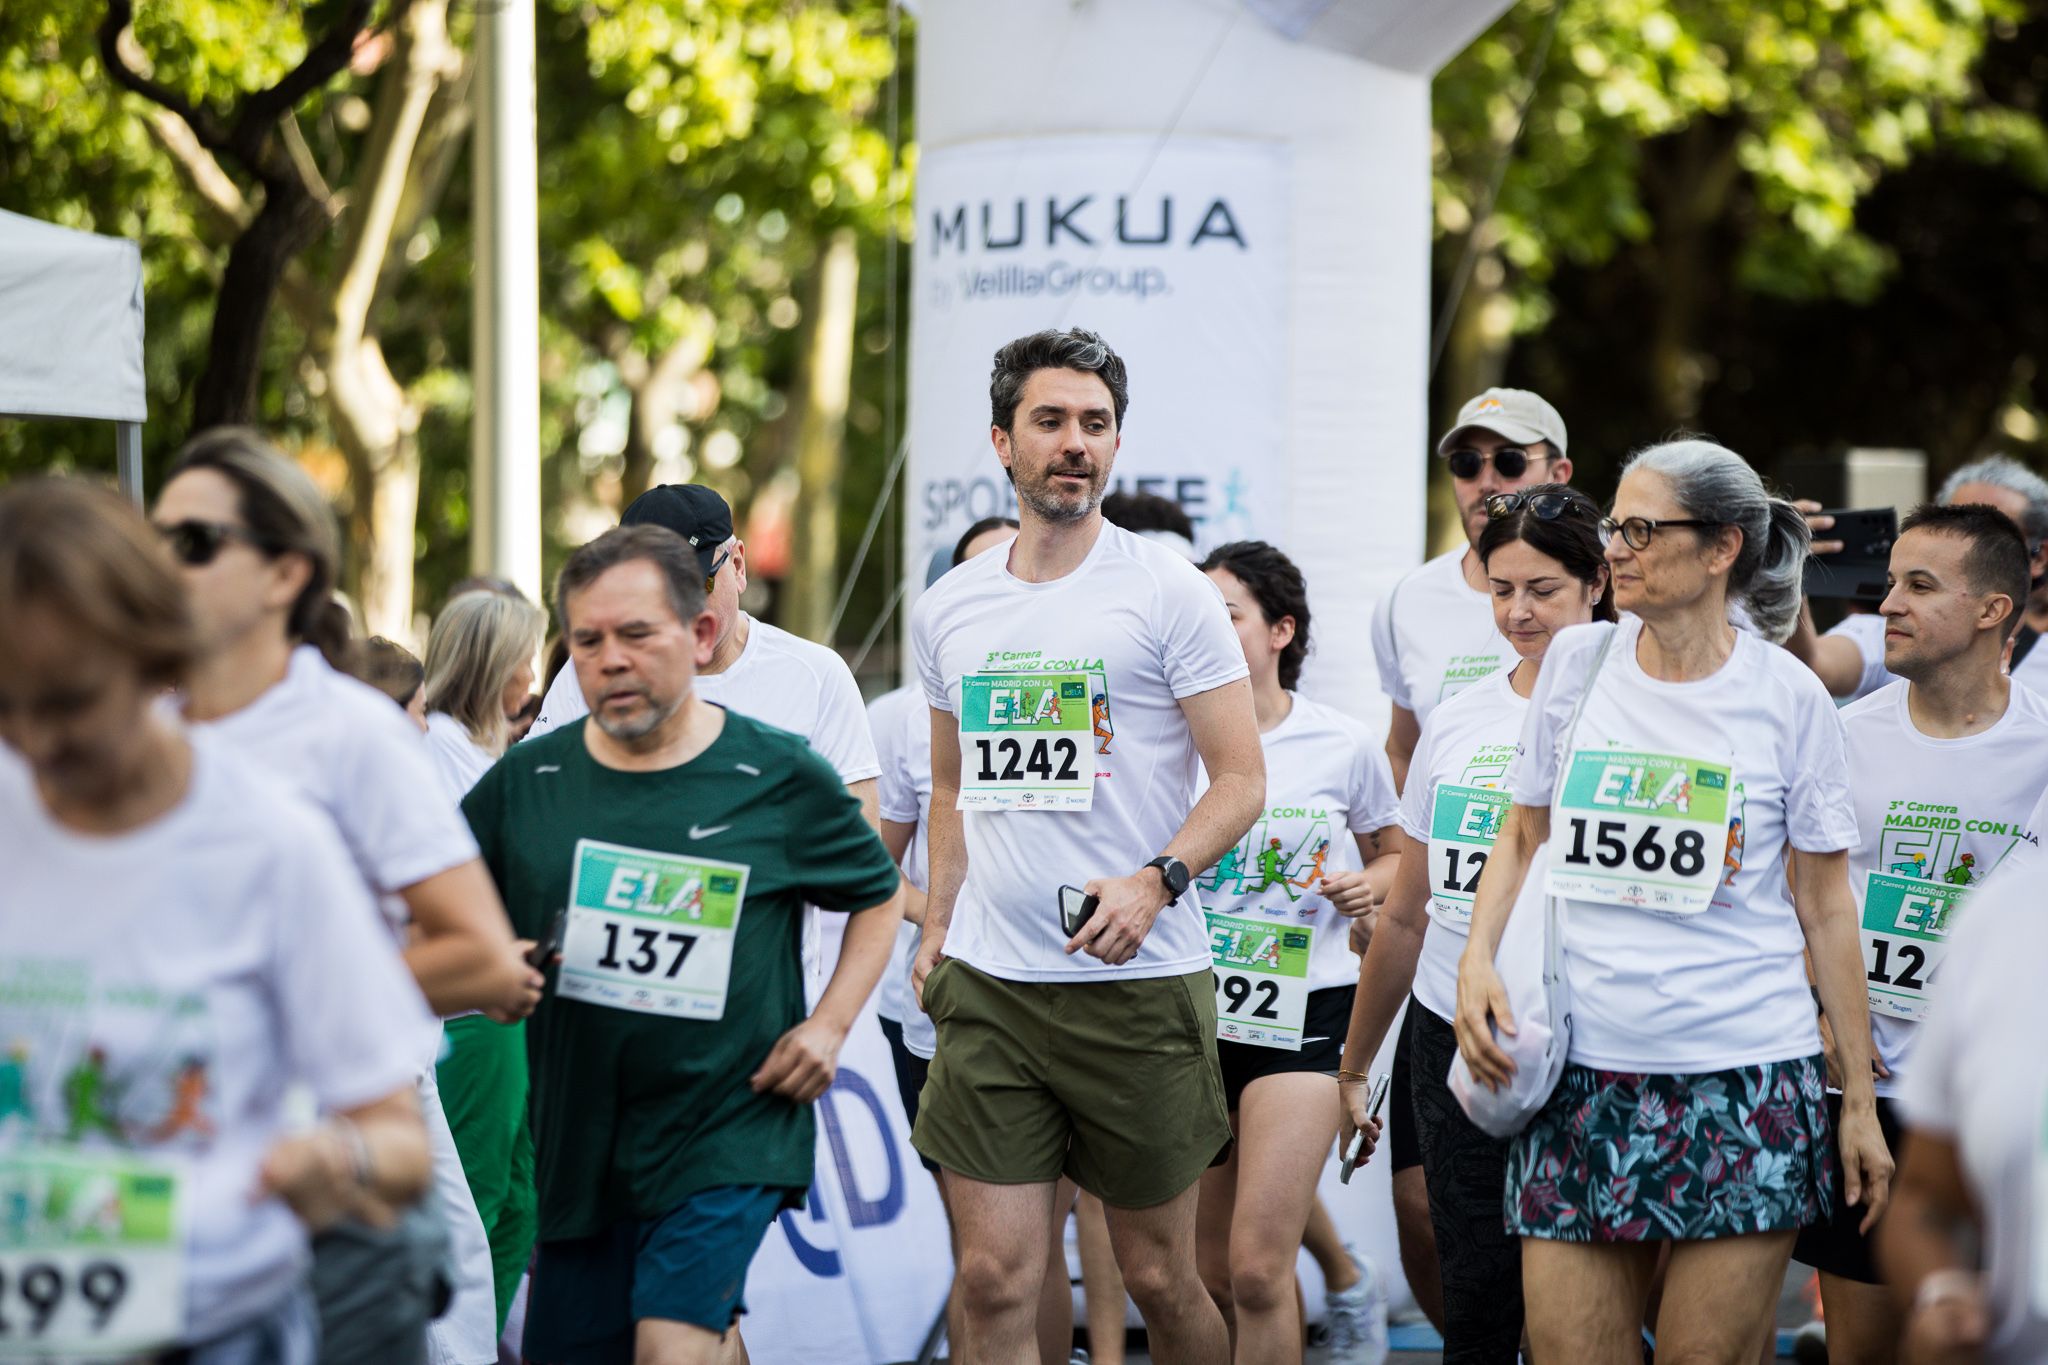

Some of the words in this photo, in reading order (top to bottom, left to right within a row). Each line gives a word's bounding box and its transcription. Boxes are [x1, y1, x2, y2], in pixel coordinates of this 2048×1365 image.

[931, 195, 1249, 257] MUKUA
[1002, 650, 1042, 661] Carrera
[1043, 660, 1080, 671] CON
[1082, 658, 1105, 671] LA
[1023, 679, 1041, 687] CON
[1042, 679, 1054, 687] LA
[987, 688, 1063, 726] ELA
[975, 737, 1079, 781] 1242
[1592, 764, 1690, 814] ELA
[1907, 801, 1958, 814] Carrera
[1272, 808, 1306, 819] CON
[1311, 808, 1329, 819] LA
[1884, 814, 1961, 830] MADRID
[1965, 819, 2009, 835] CON
[1564, 817, 1706, 878] 1568
[1443, 847, 1488, 894] 12
[1906, 885, 1947, 898] MADRID
[604, 866, 704, 921] ELA
[1211, 919, 1245, 930] MADRID
[1246, 924, 1265, 932] CON
[596, 921, 699, 980] 137
[1867, 938, 1926, 991] 12
[1213, 971, 1281, 1020] 92
[0, 1259, 129, 1341] 99
